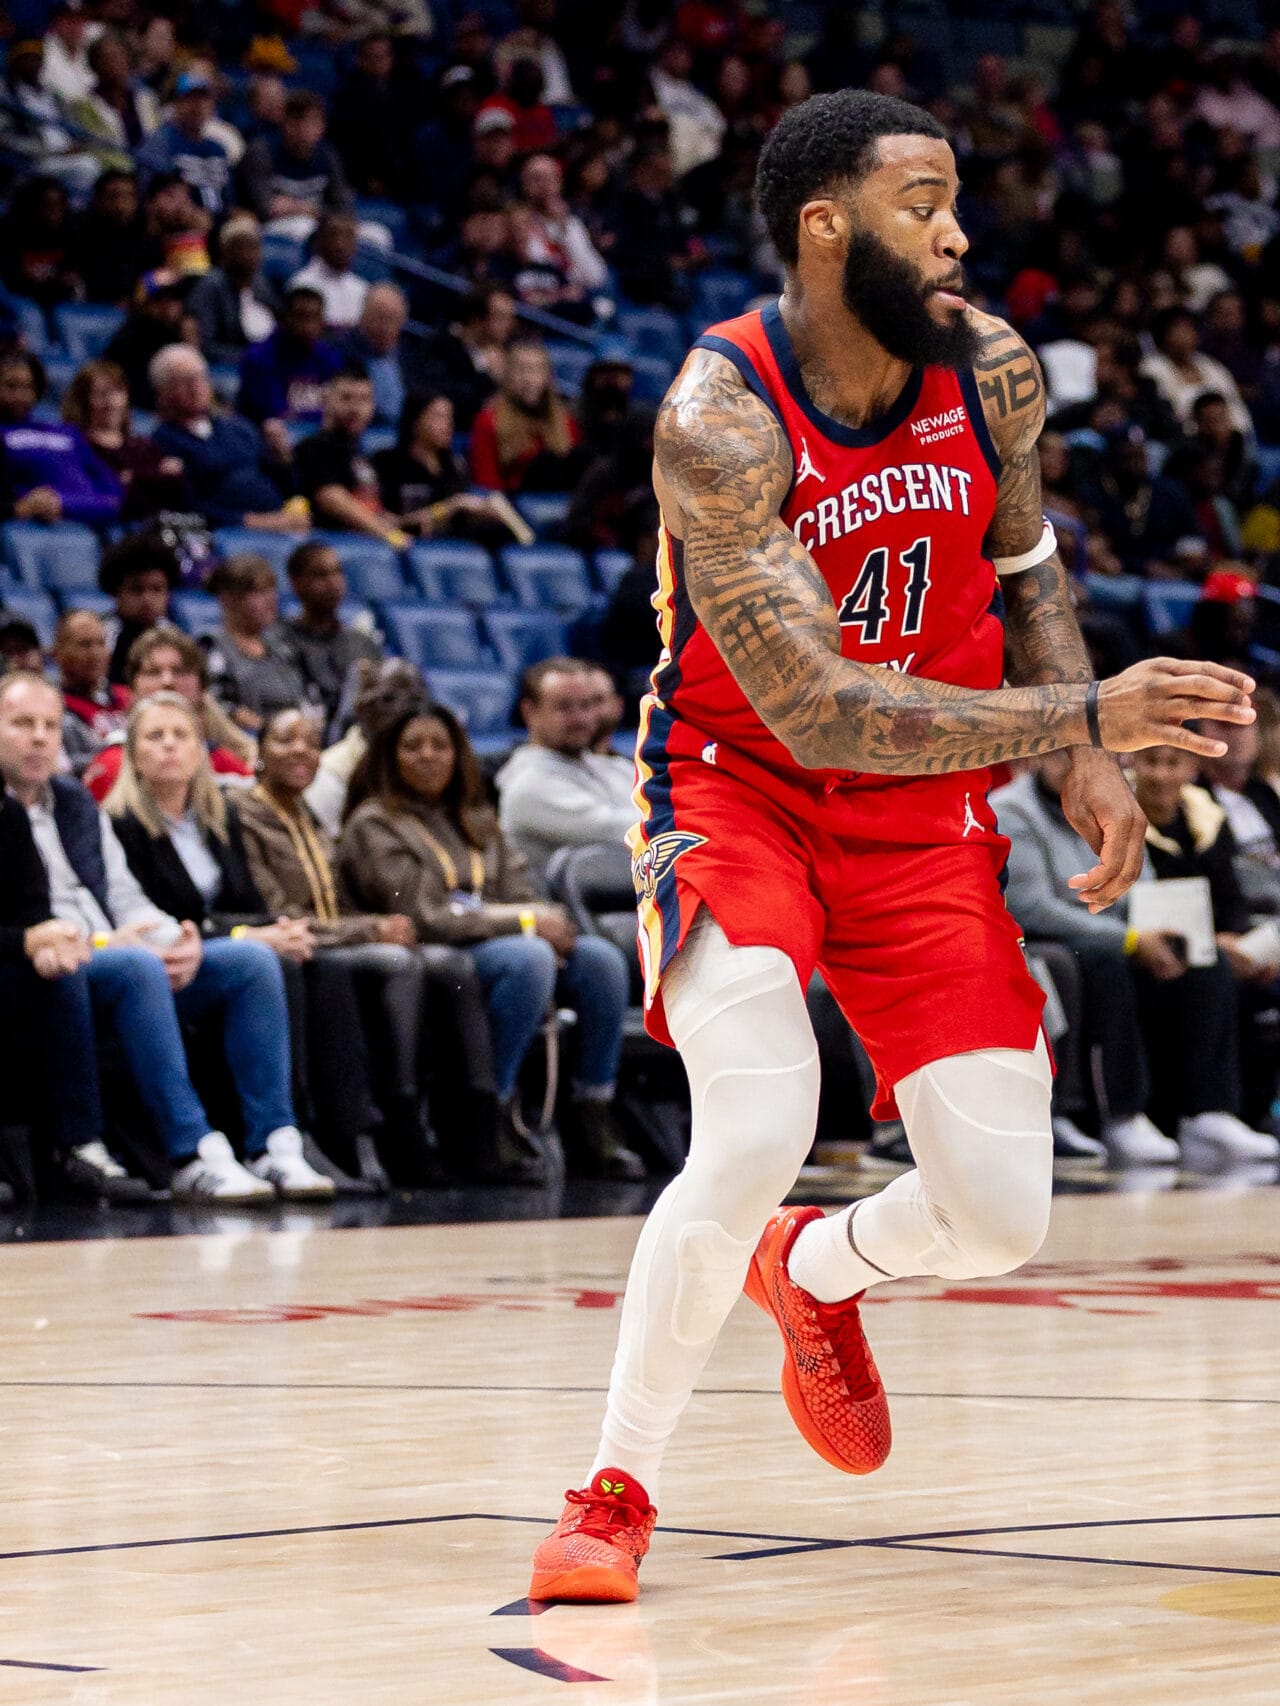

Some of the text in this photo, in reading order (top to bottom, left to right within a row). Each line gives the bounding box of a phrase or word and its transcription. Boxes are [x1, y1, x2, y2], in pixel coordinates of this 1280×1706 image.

[910, 406, 966, 437] NEWAGE
[920, 424, 965, 446] PRODUCTS
[793, 463, 972, 552] CRESCENT
[837, 536, 932, 645] 41
